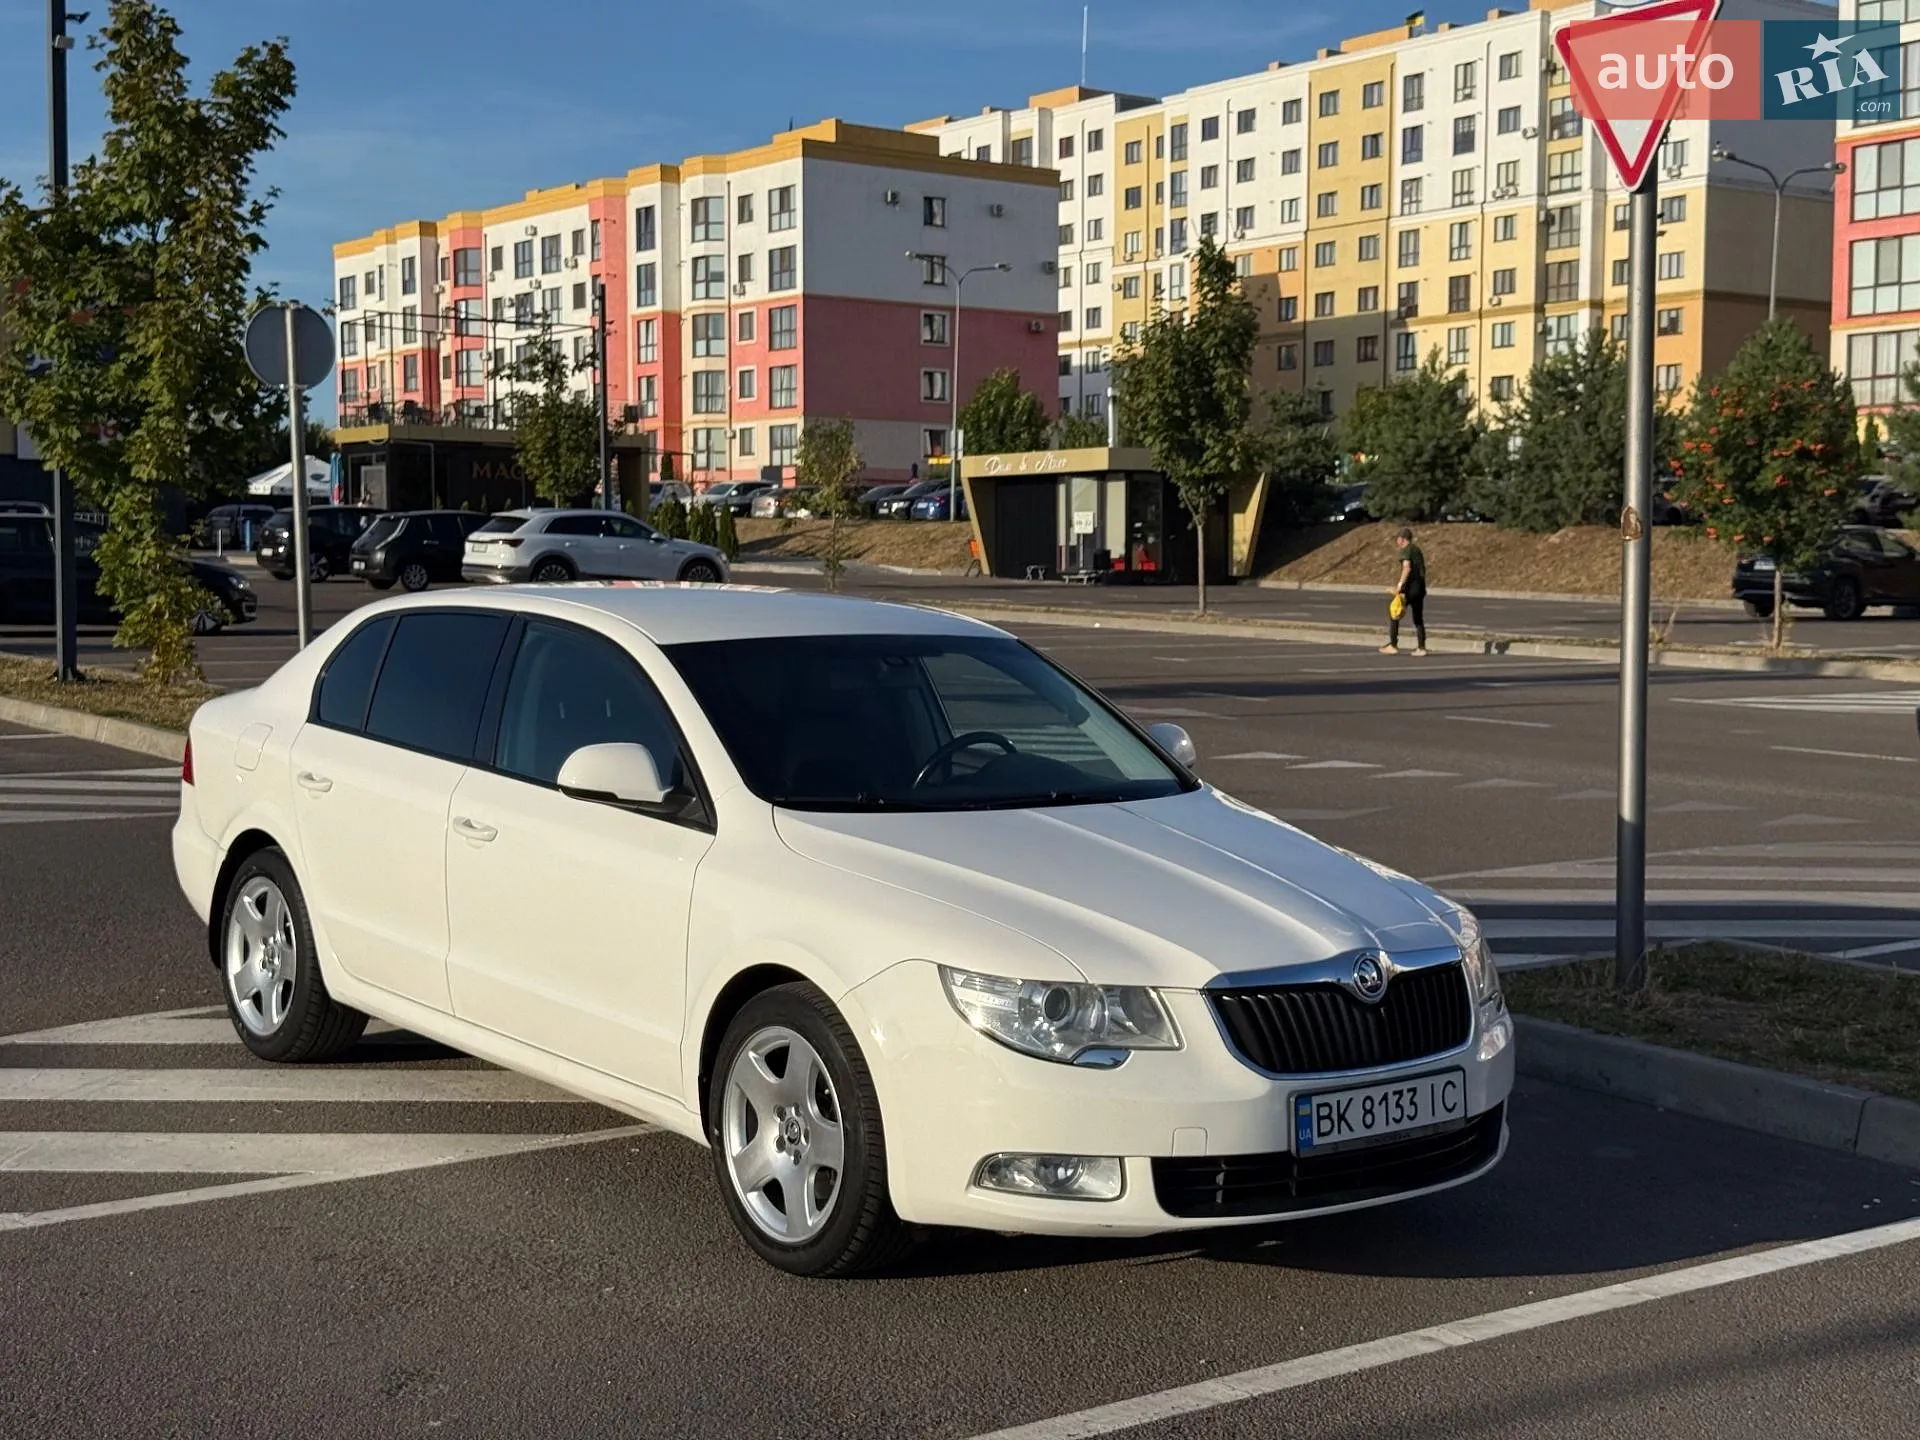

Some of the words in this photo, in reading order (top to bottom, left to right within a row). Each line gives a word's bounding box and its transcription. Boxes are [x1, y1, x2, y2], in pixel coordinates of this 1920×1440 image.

[1316, 1097, 1355, 1138] BK
[1362, 1087, 1418, 1130] 8133
[1431, 1080, 1458, 1117] IC
[1299, 1128, 1312, 1141] UA
